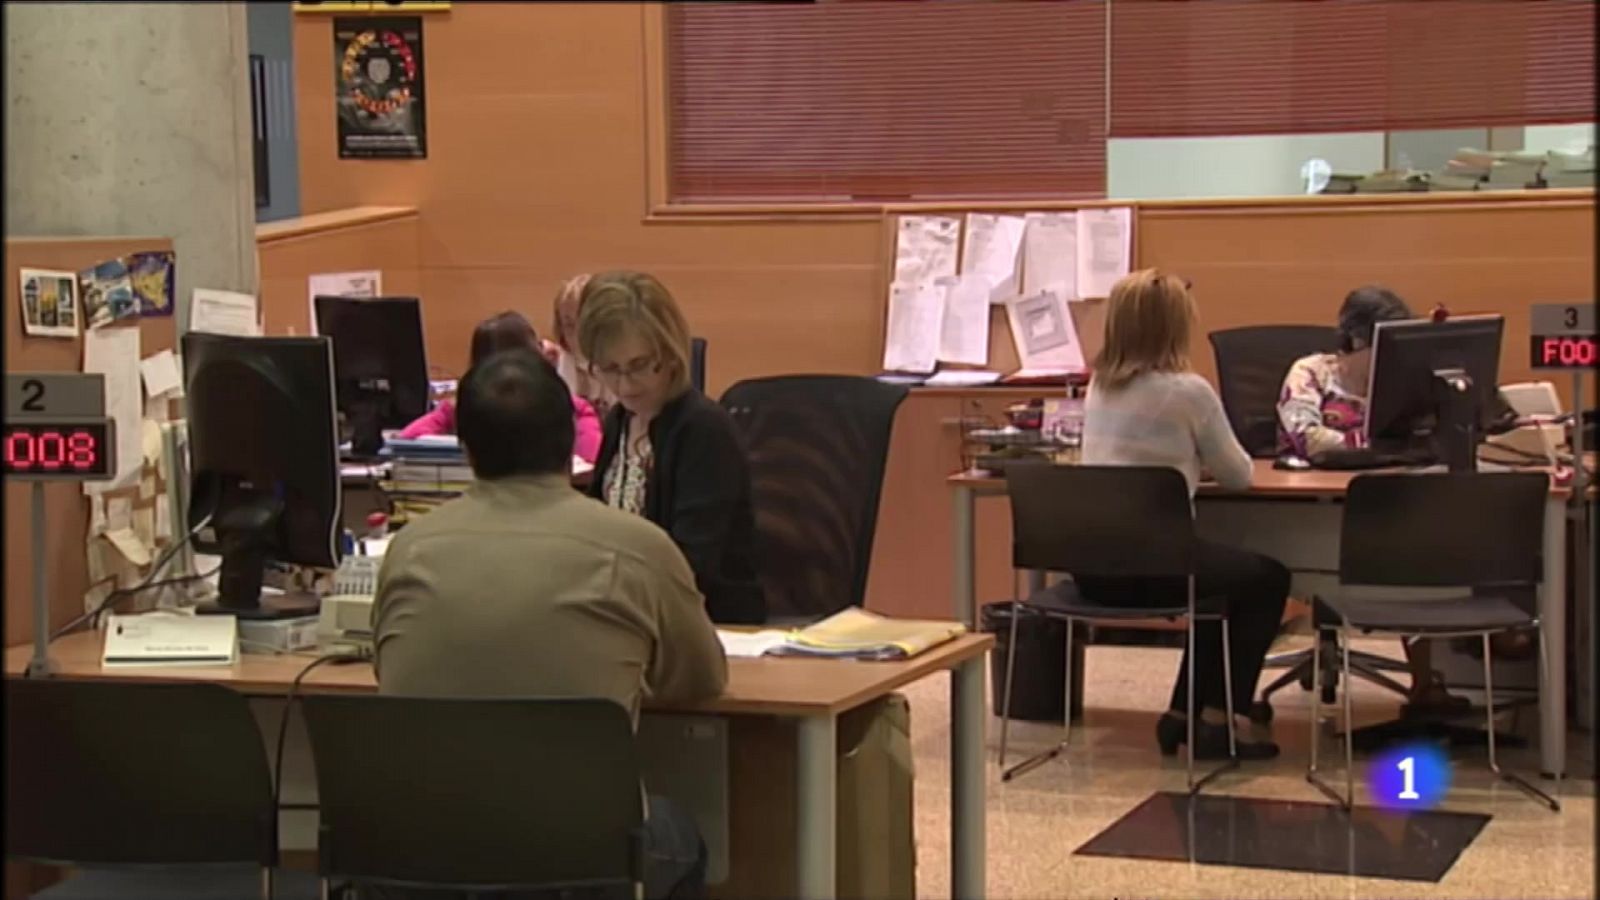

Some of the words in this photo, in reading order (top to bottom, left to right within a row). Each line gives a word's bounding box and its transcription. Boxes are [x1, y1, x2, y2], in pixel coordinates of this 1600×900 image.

[1564, 307, 1578, 329] 3
[21, 379, 46, 411] 2
[7, 432, 95, 467] 008
